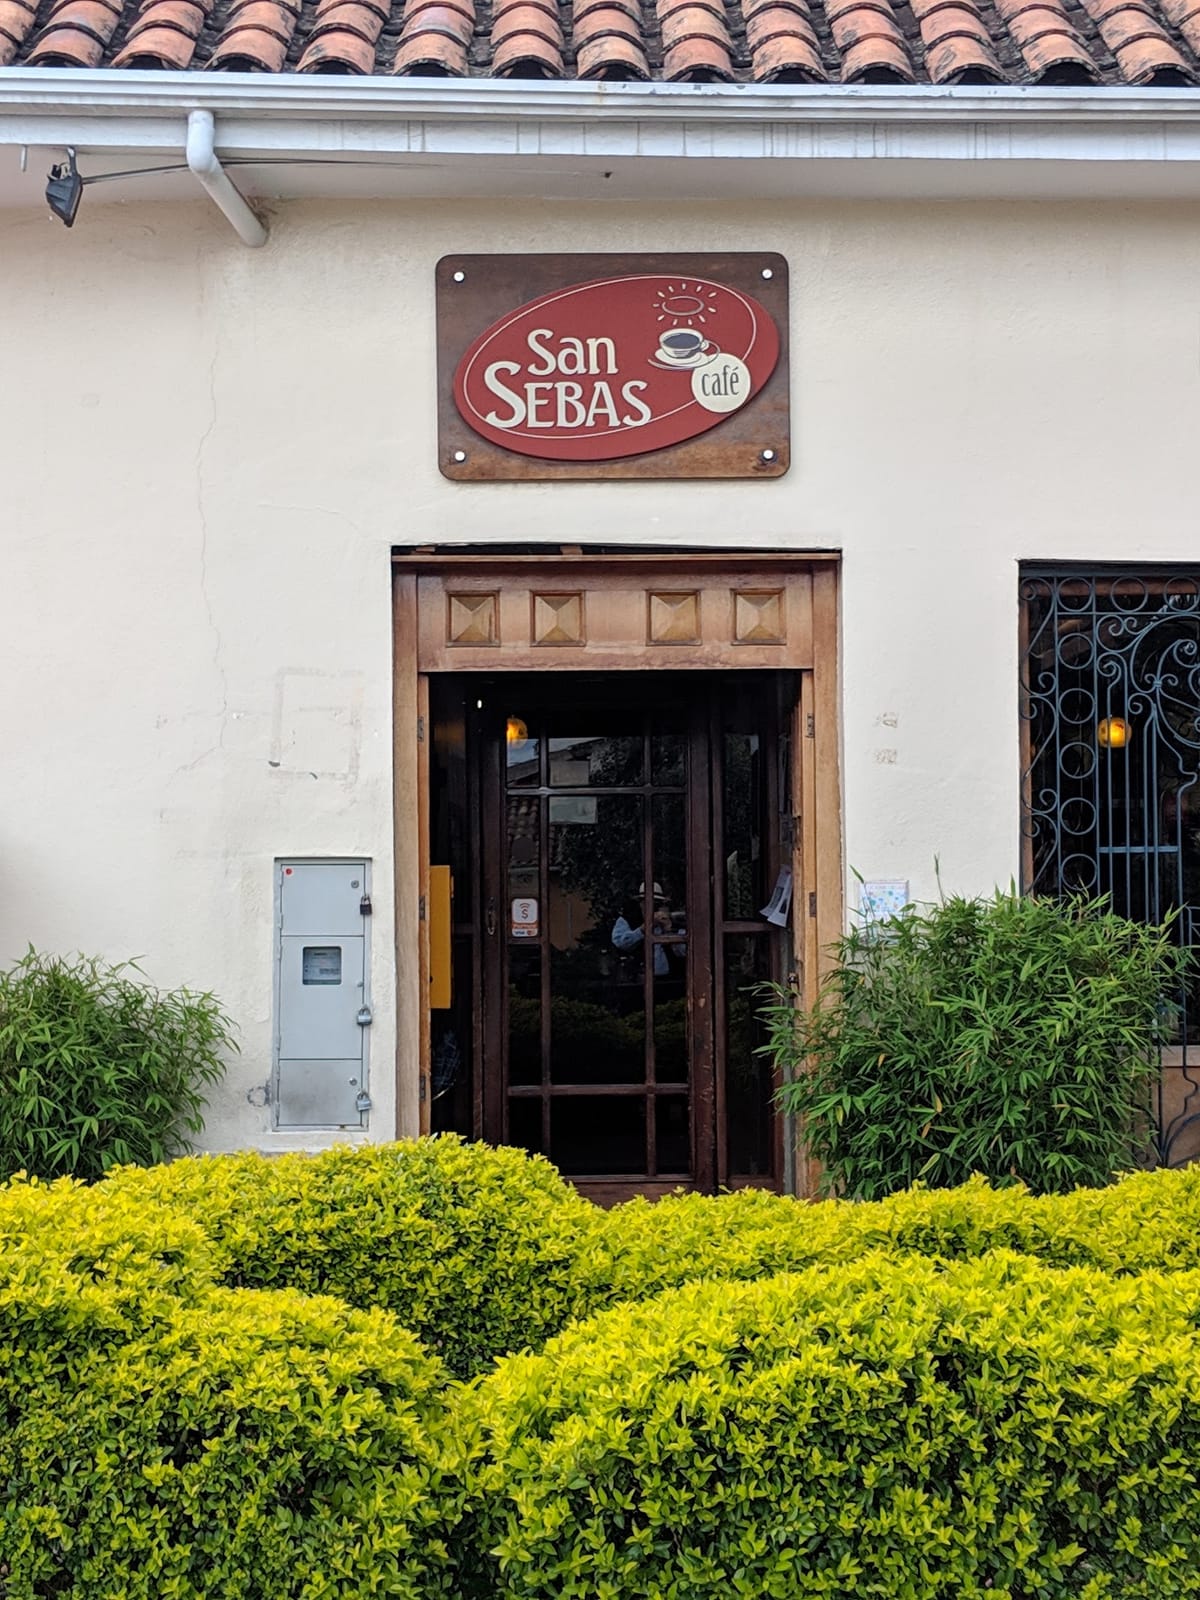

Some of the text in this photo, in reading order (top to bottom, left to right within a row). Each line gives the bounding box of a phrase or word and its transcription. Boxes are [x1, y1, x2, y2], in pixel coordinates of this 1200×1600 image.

[527, 329, 619, 376] San
[484, 360, 652, 428] SEBAS
[702, 364, 740, 397] café
